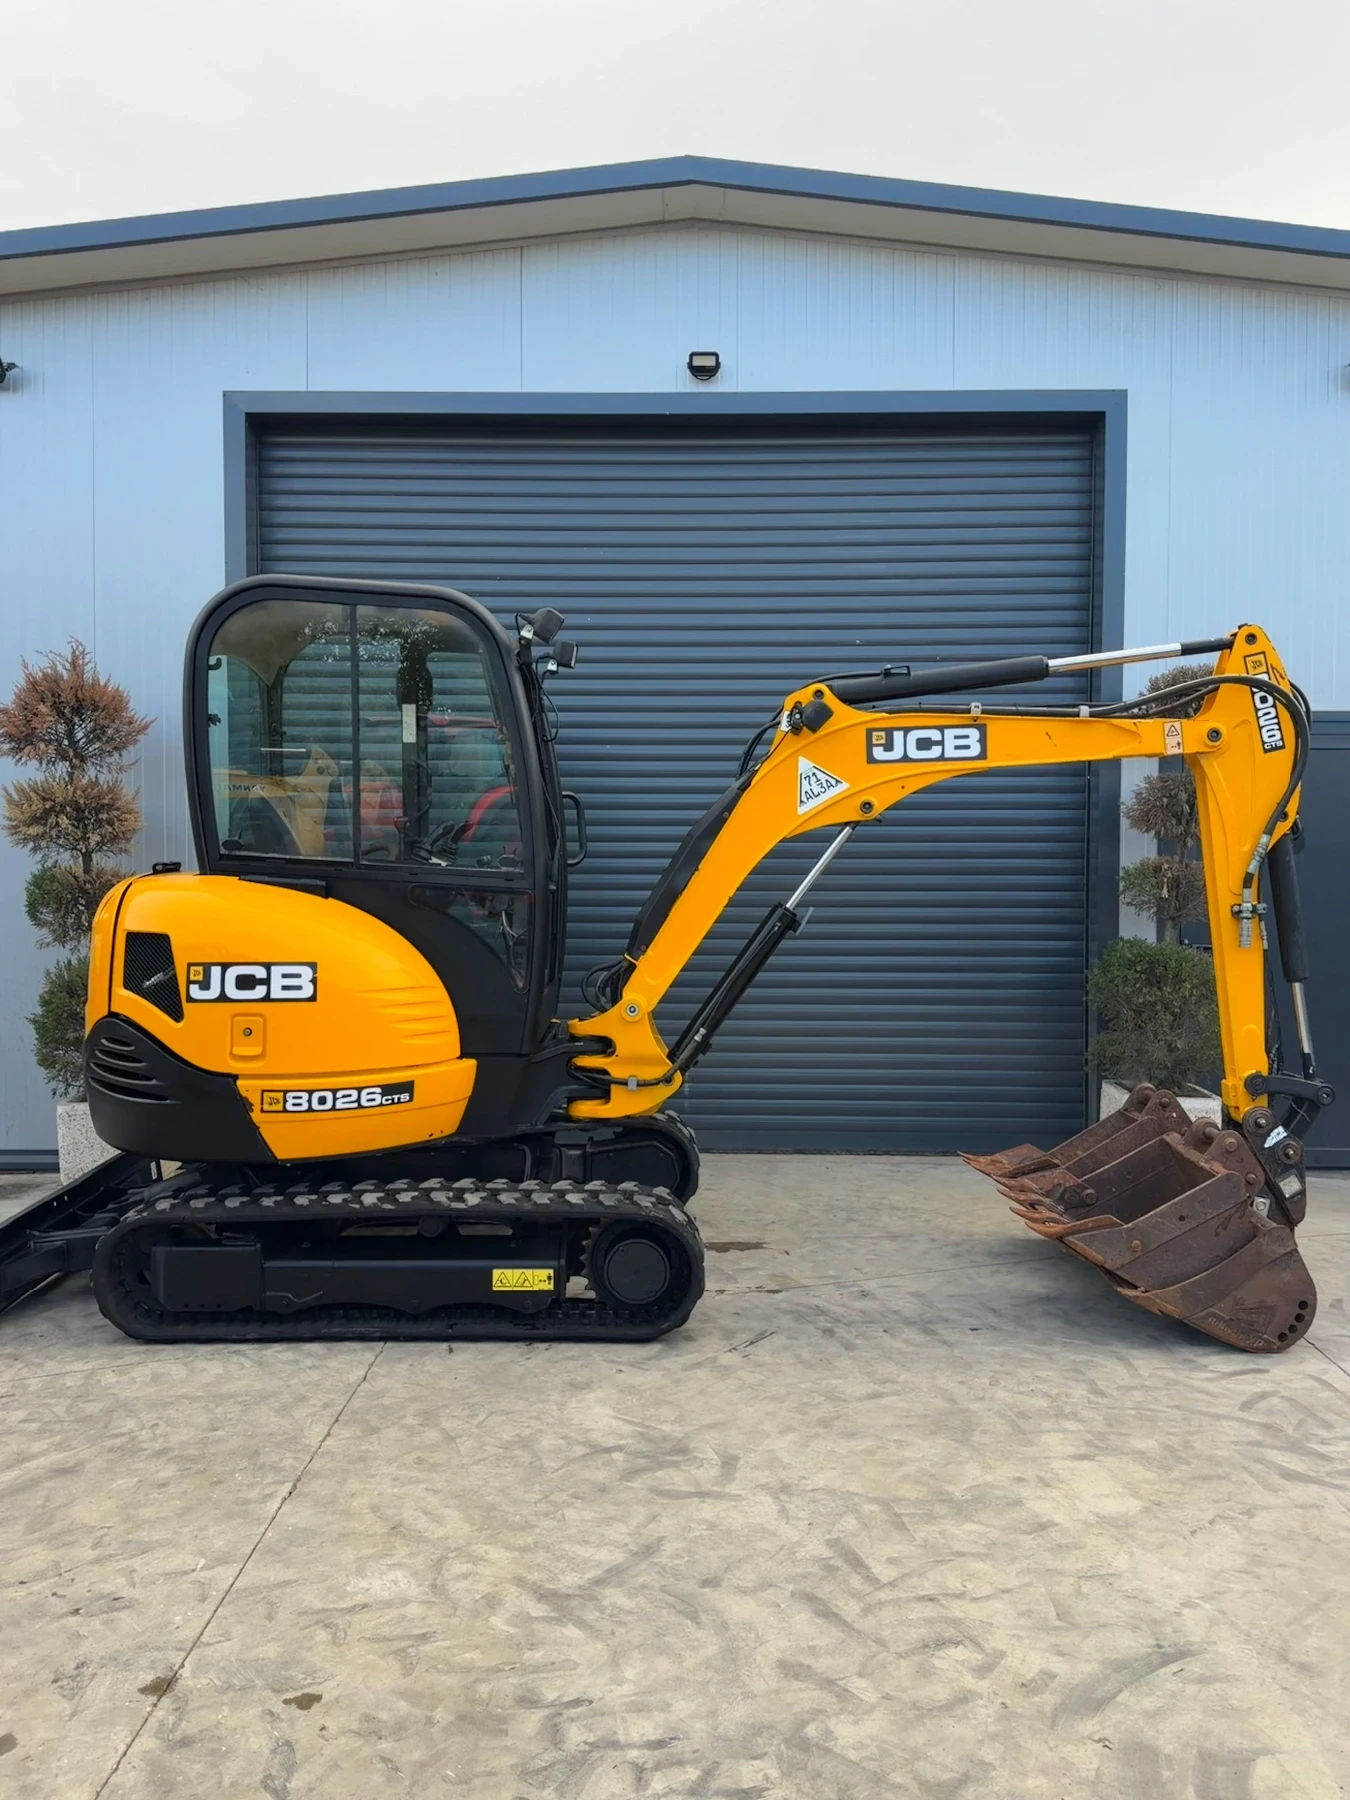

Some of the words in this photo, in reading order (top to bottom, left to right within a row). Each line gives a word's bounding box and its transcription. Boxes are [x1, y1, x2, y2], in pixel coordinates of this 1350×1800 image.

[872, 728, 981, 761] JCB
[1264, 741, 1283, 749] CTS
[804, 772, 821, 787] 71
[804, 779, 835, 802] AL3A
[189, 965, 314, 1000] JCB
